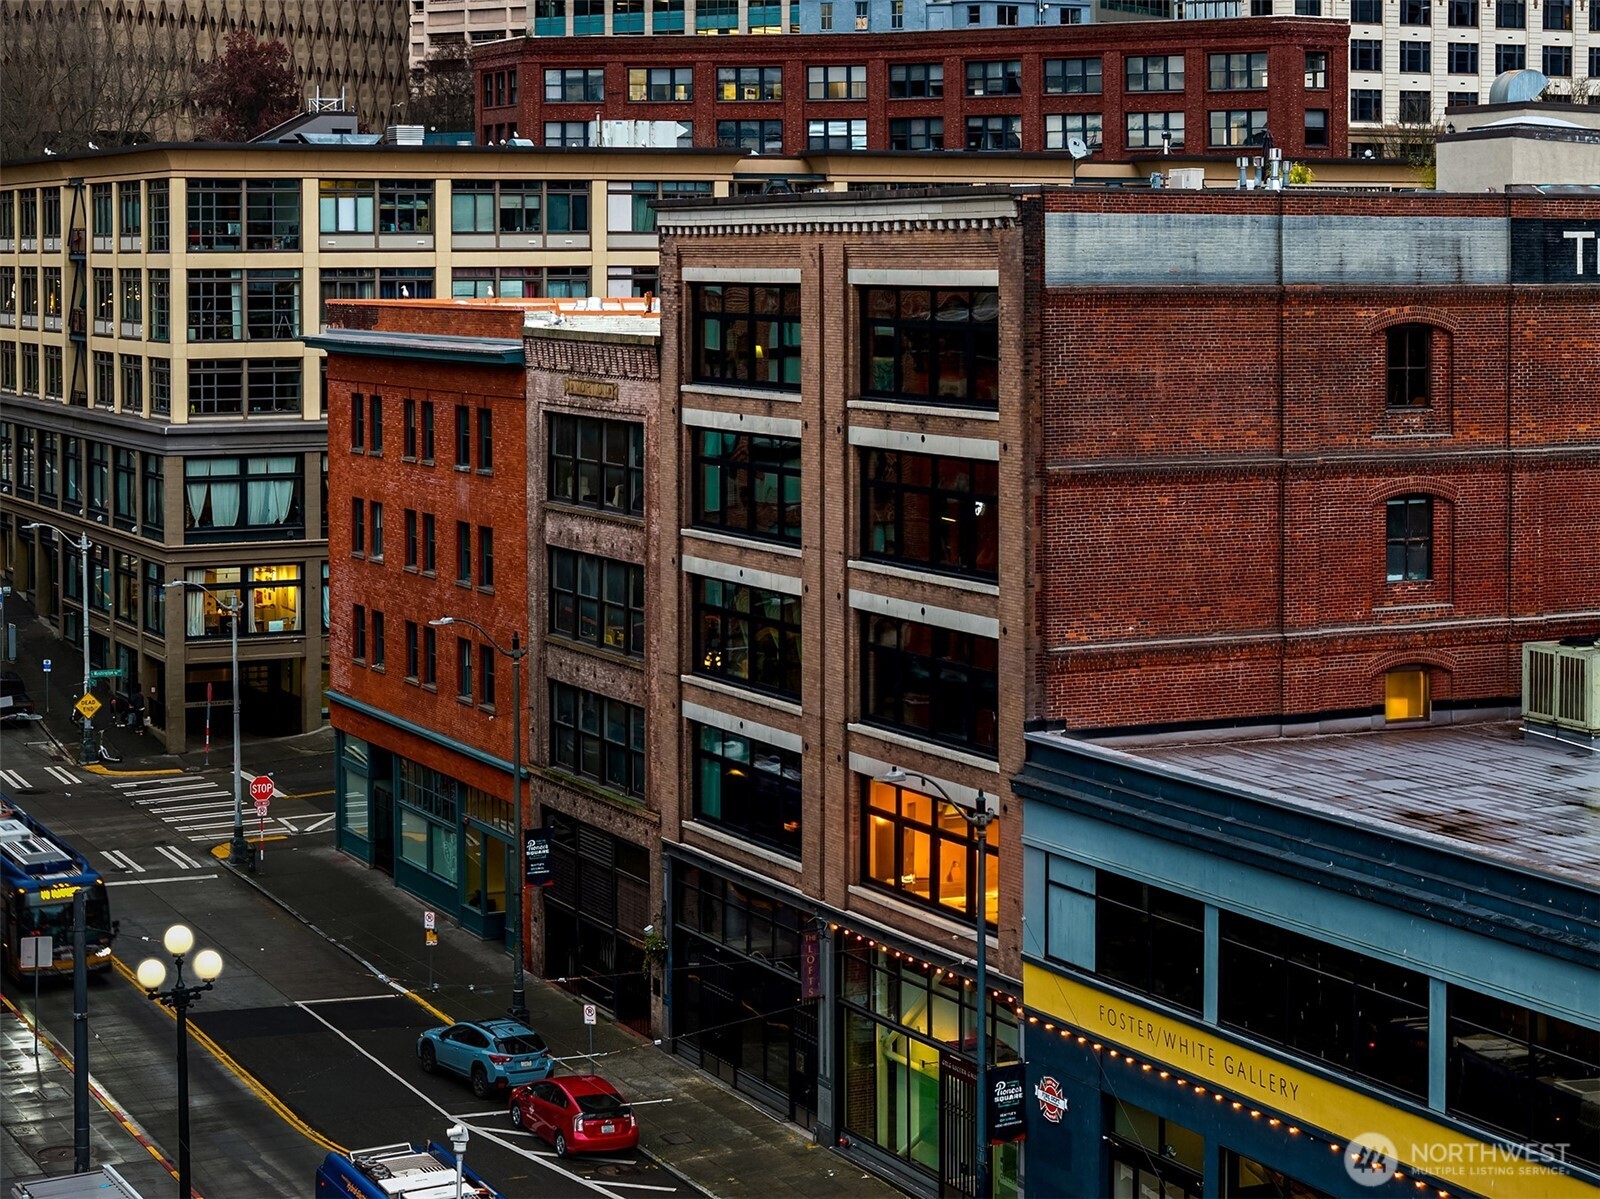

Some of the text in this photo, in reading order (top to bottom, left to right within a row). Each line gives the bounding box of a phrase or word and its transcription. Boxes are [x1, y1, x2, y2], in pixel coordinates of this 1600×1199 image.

[1563, 231, 1600, 275] T
[252, 783, 272, 794] STOP
[807, 944, 815, 998] LOFTS
[1100, 1005, 1299, 1101] FOSTER/WHITE GALLERY
[994, 1092, 1024, 1103] SQUARE
[995, 1081, 1023, 1096] Pioneer
